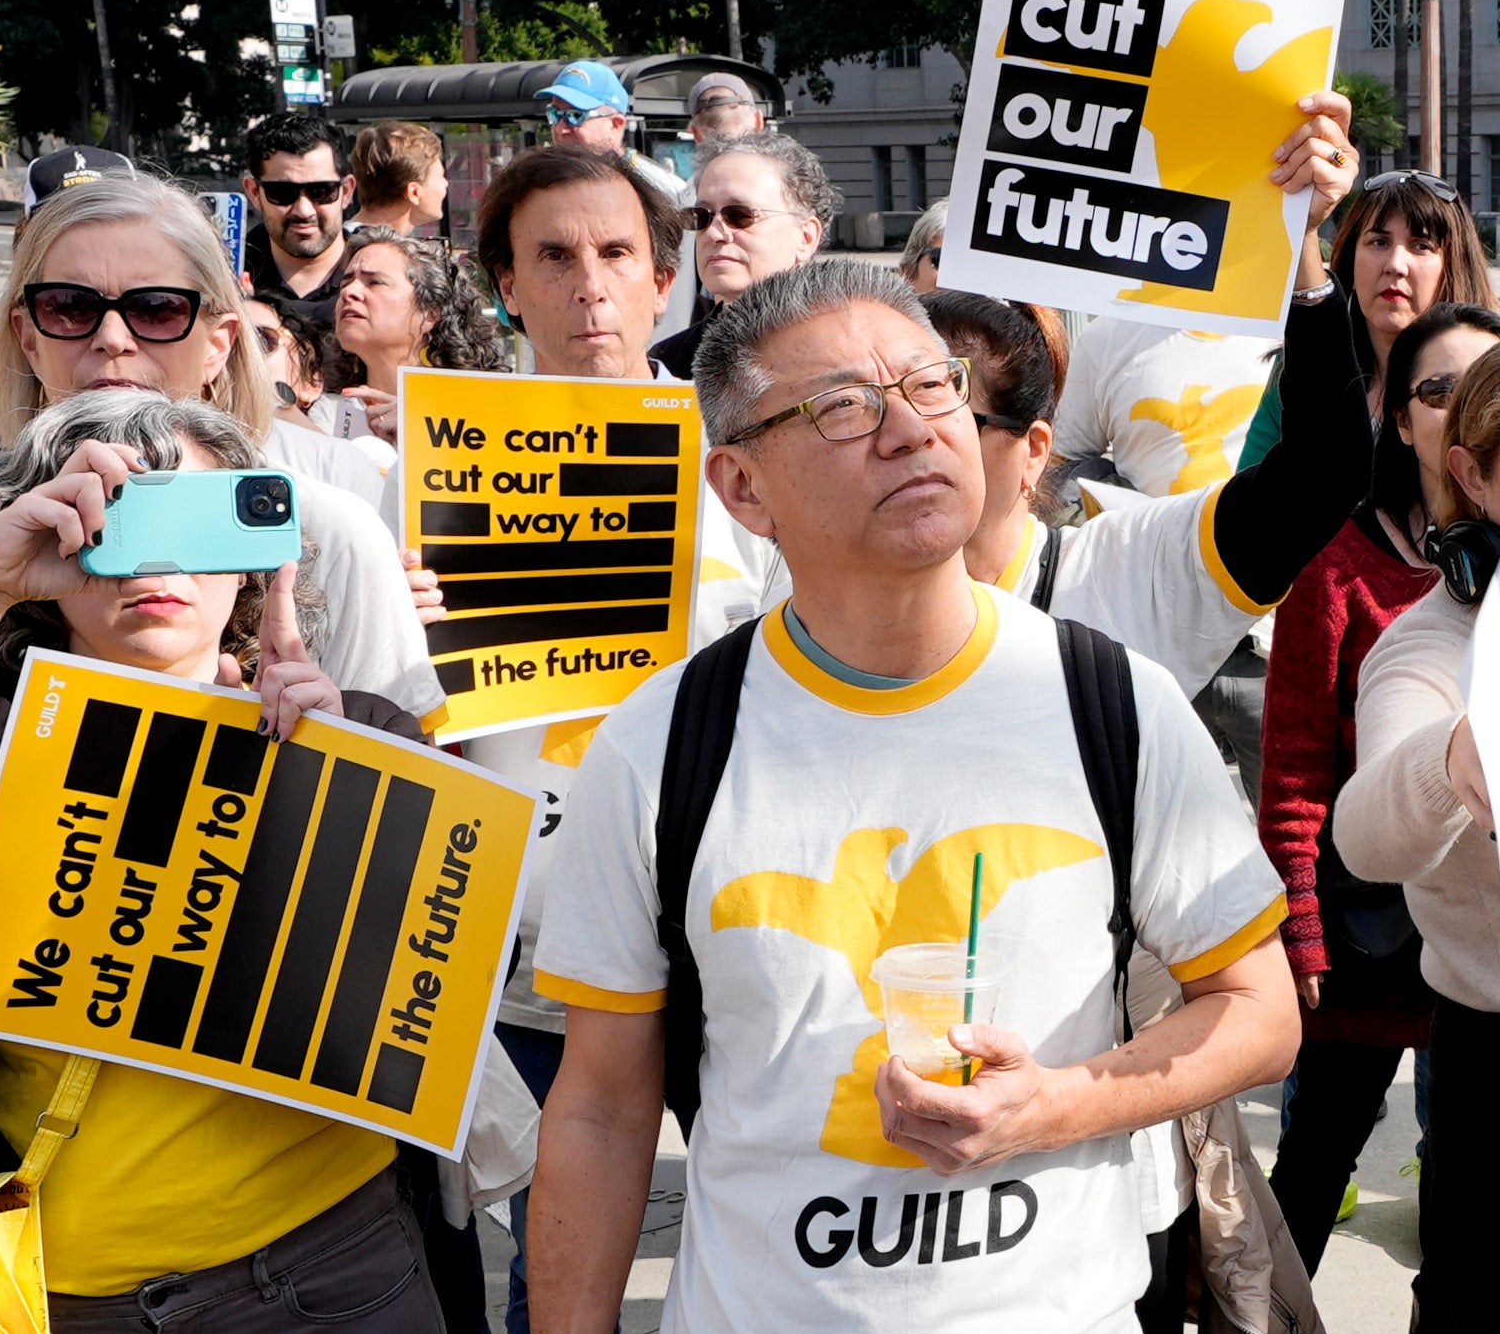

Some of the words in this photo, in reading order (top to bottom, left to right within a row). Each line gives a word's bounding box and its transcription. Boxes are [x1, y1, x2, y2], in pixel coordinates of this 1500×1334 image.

[1002, 92, 1134, 152] our
[986, 167, 1209, 271] future
[424, 416, 487, 450] We
[504, 424, 599, 453] can't
[642, 397, 680, 409] GUILD
[423, 464, 482, 493] cut
[492, 472, 554, 495] our
[496, 513, 580, 541] way
[590, 506, 626, 532] to
[481, 654, 538, 687] the
[546, 647, 657, 677] future.
[35, 692, 62, 738] GUILD
[196, 793, 247, 840] to
[6, 938, 71, 1008] We
[49, 800, 109, 917] can't
[109, 866, 158, 946] our
[172, 849, 244, 953] way
[408, 818, 482, 962] future.
[87, 954, 135, 1028] cut
[391, 970, 442, 1044] the
[794, 1179, 1039, 1269] GUILD
